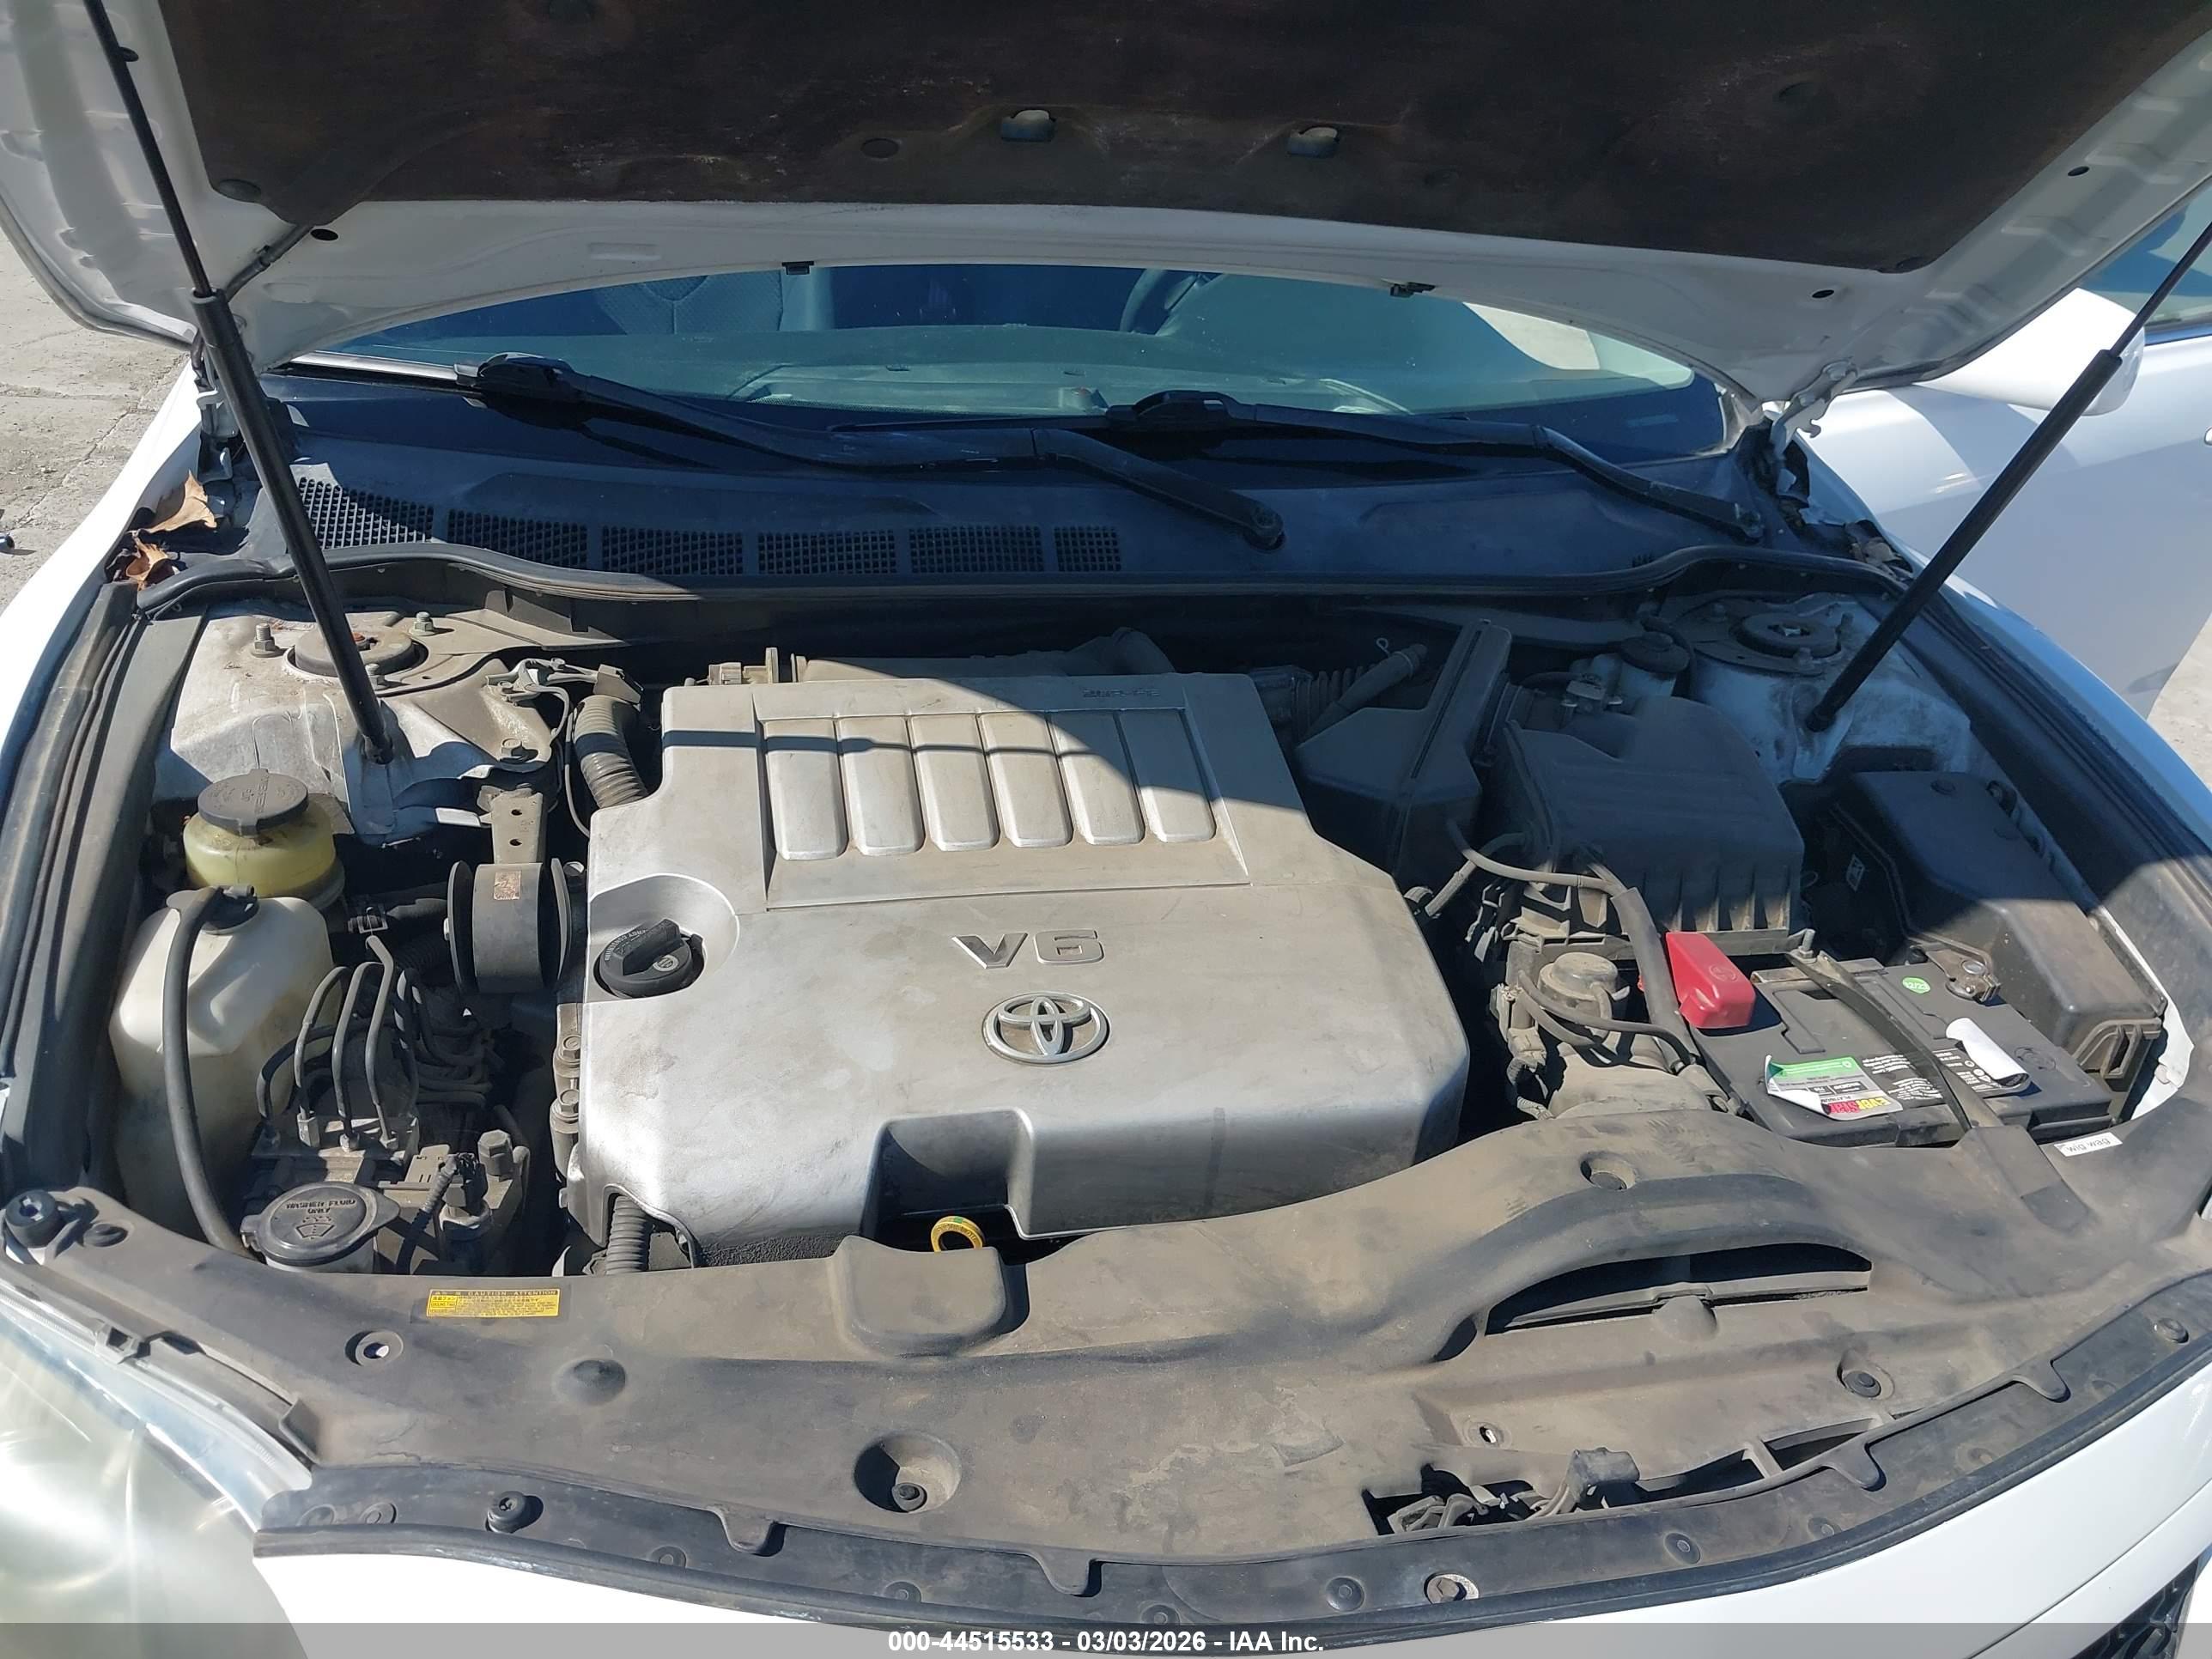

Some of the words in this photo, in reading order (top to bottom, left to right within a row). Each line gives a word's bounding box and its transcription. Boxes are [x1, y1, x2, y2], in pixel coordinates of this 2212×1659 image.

[951, 929, 1105, 969] V6
[2066, 1144, 2087, 1152] wig
[2087, 1138, 2111, 1147] wag
[285, 1200, 325, 1209] WASHER
[328, 1199, 356, 1208] FLUID
